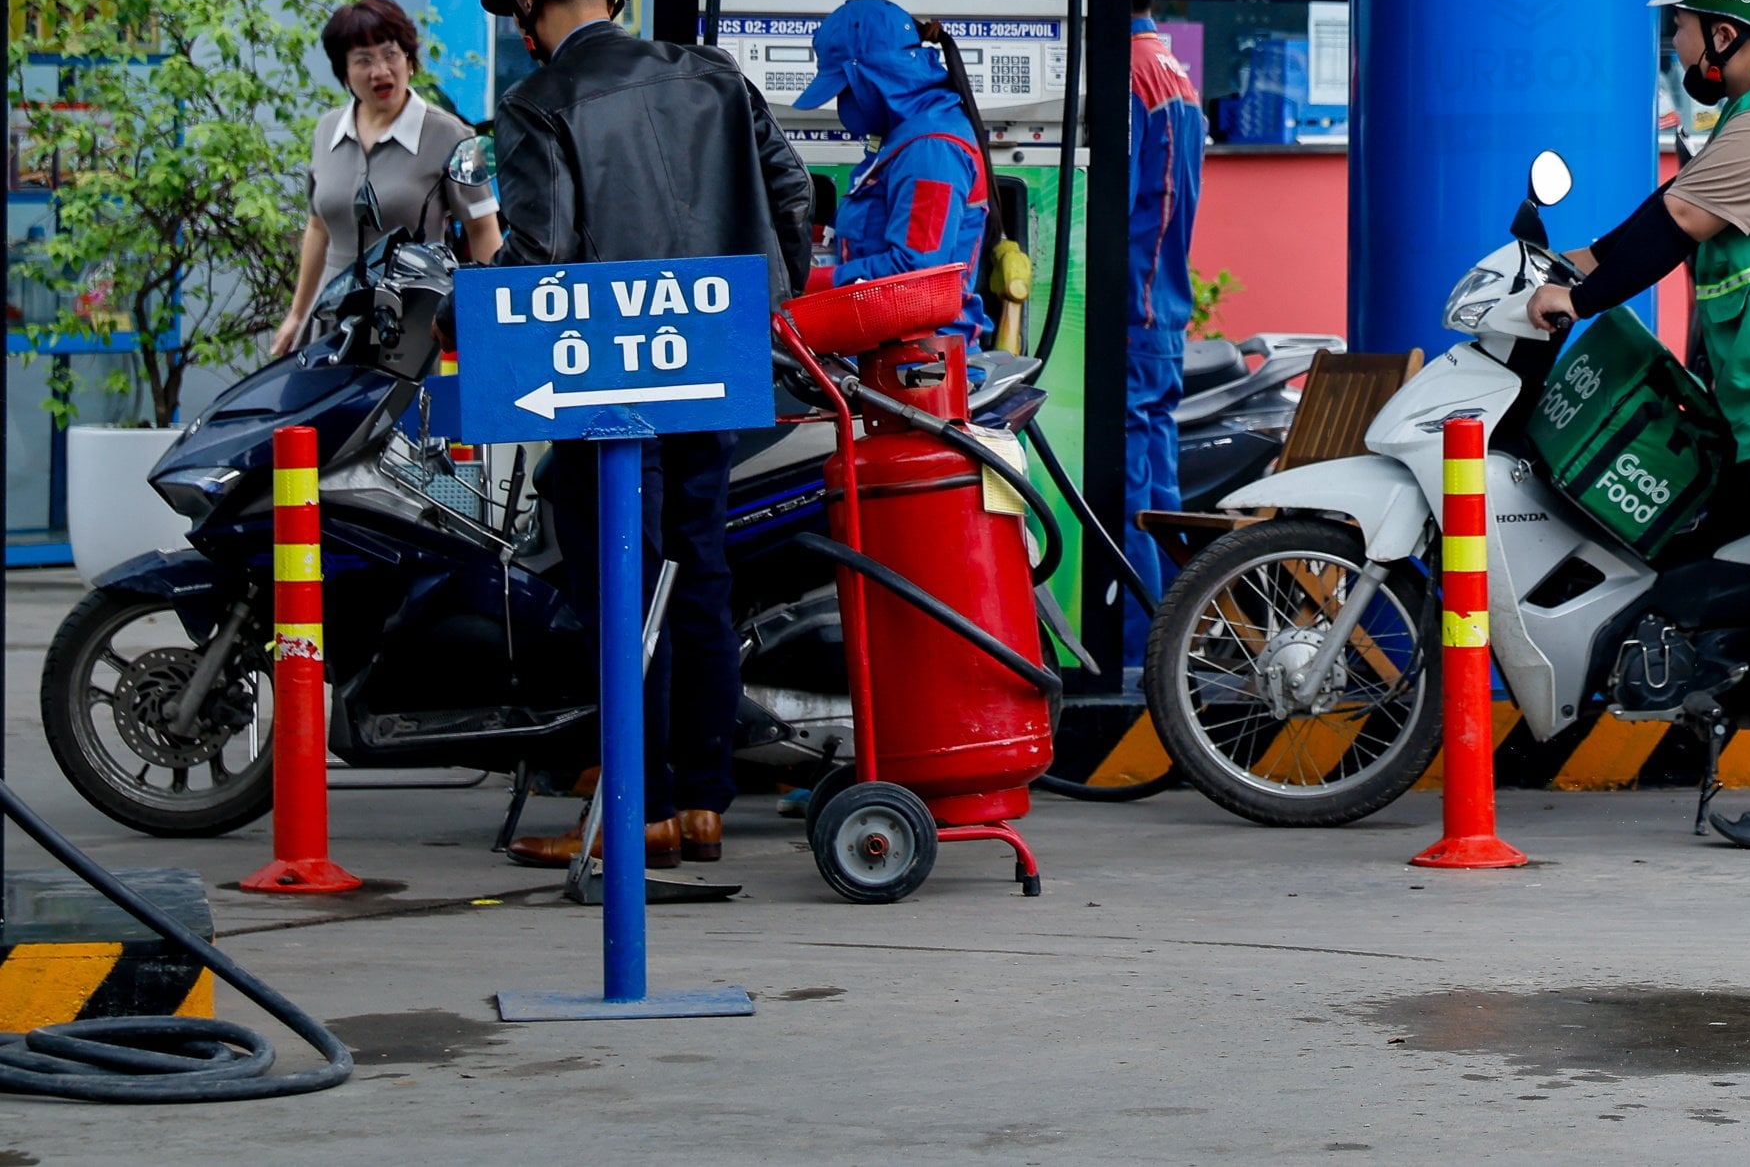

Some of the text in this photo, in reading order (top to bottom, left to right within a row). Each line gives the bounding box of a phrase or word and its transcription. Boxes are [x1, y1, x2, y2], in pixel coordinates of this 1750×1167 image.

[745, 21, 766, 33] 02:
[770, 21, 821, 34] 2025/P
[942, 22, 1054, 37] CCS 01: 2025/PVOIL
[786, 130, 807, 140] RẢ
[495, 270, 730, 324] LỐI VÀO
[553, 326, 688, 375] Ô TÔ
[1564, 354, 1604, 400] Grab
[1538, 381, 1584, 430] Food
[1596, 470, 1659, 524] Food
[1615, 453, 1671, 504] Grab
[1496, 512, 1549, 524] HONDA
